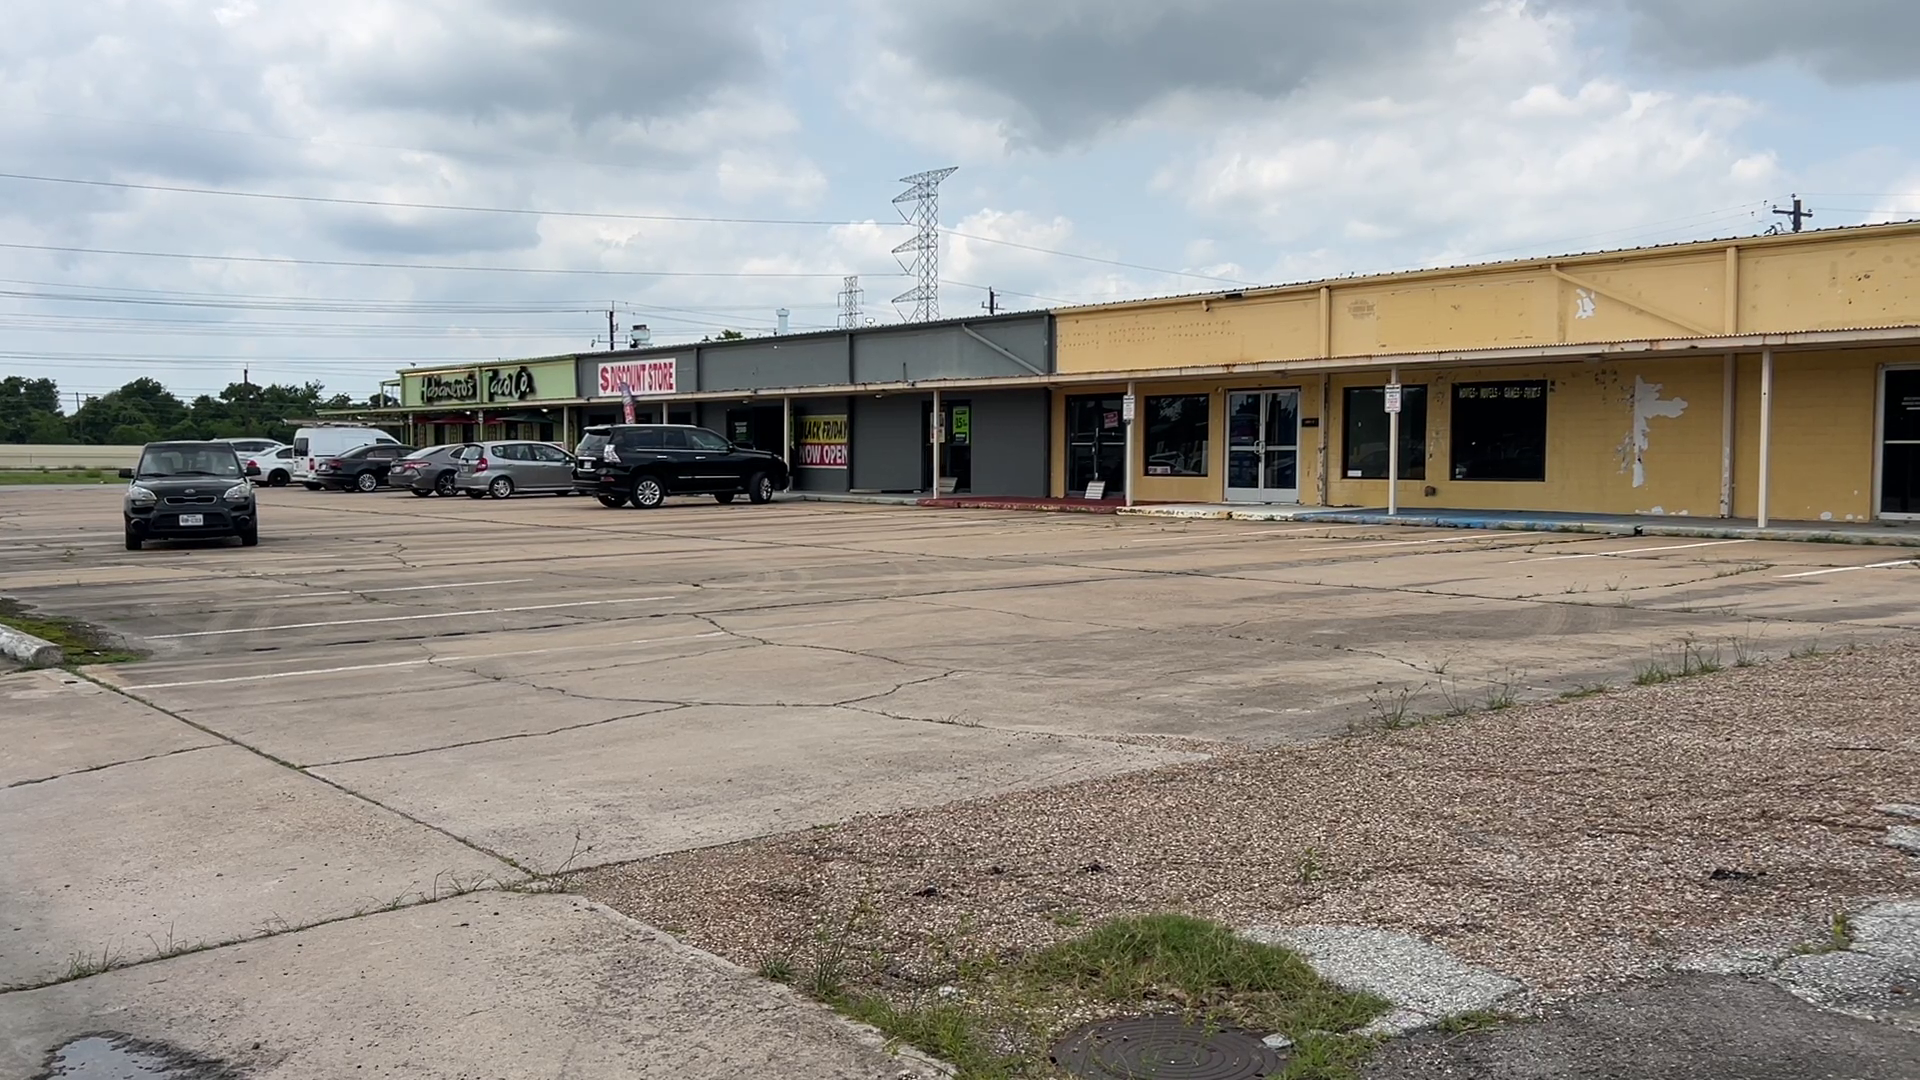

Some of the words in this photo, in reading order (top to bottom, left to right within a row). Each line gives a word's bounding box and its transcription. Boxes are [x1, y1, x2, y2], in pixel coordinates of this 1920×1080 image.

[481, 369, 512, 401] Taco
[610, 364, 647, 392] DISCOUNT
[648, 362, 674, 391] STORE
[799, 444, 822, 464] NOW
[823, 444, 848, 464] OPEN
